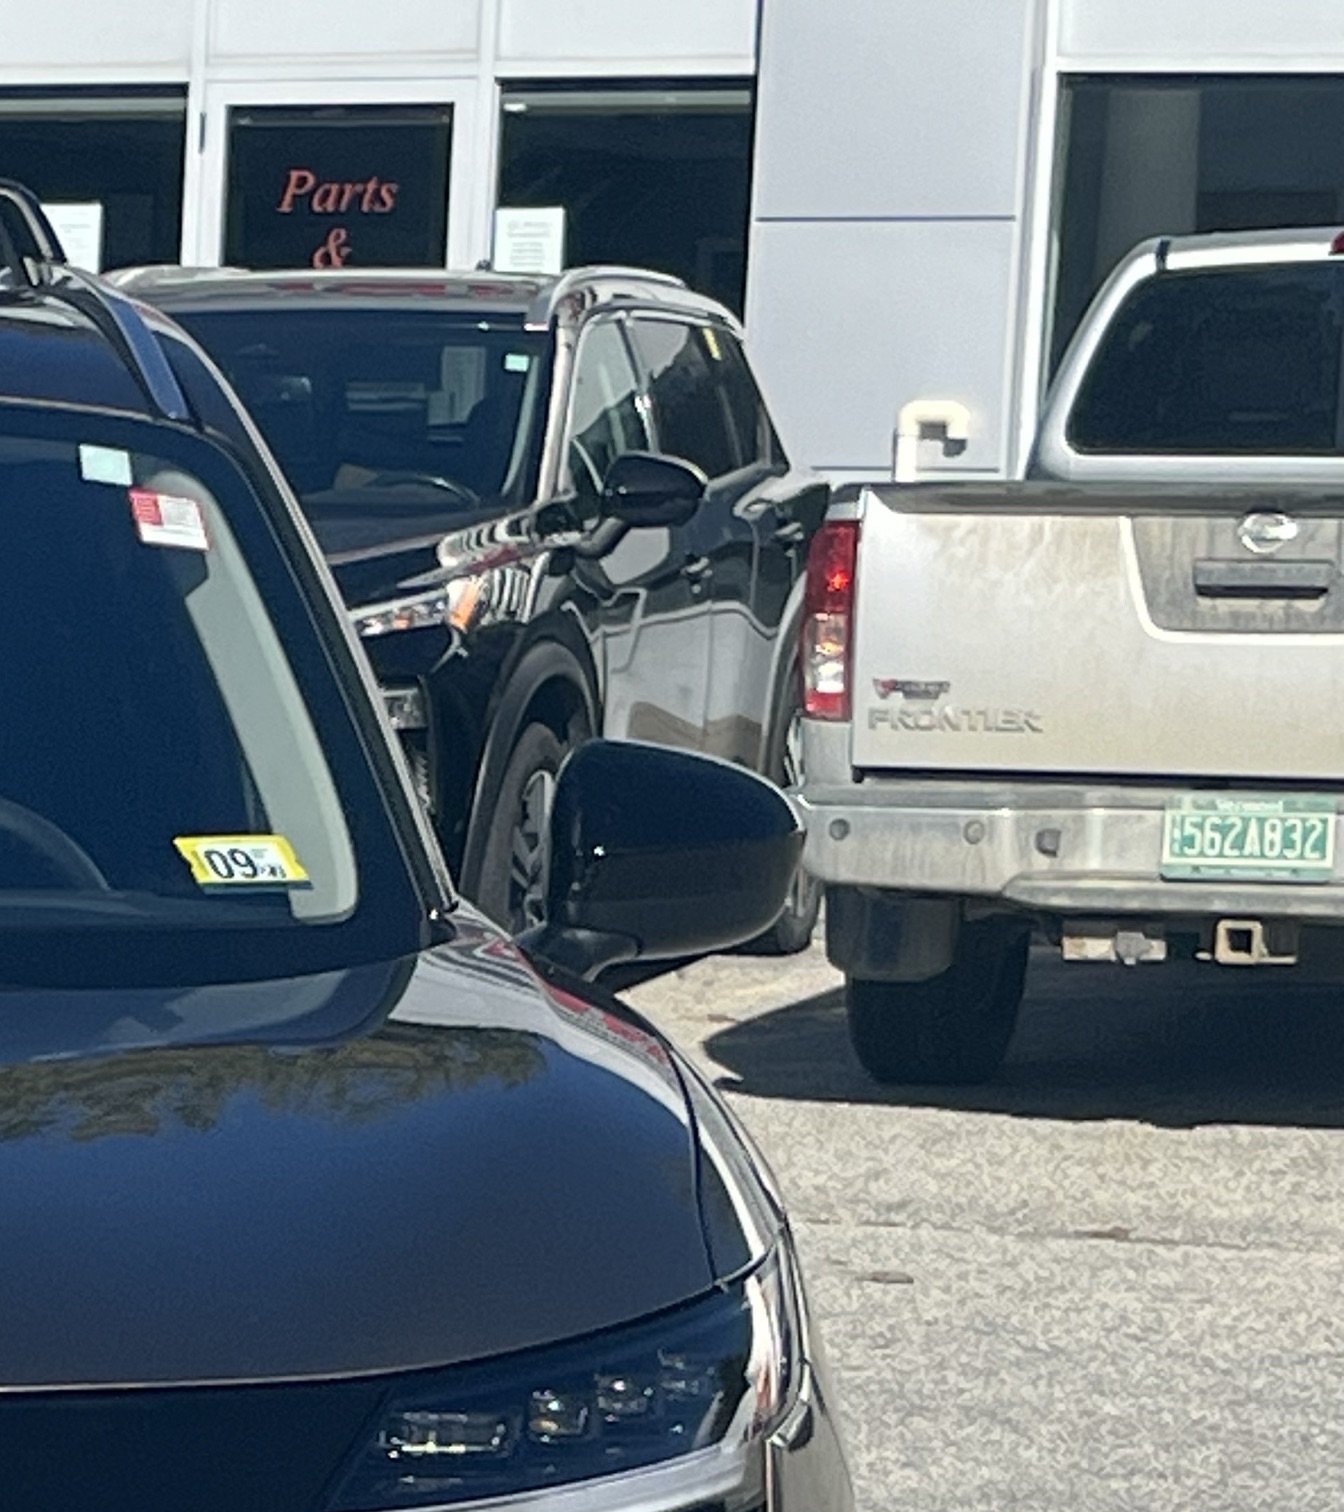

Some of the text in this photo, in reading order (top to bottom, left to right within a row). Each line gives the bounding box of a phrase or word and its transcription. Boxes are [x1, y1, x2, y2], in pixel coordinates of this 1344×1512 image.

[276, 169, 399, 213] Parts
[313, 228, 352, 269] &
[867, 707, 1044, 733] FRONTIER
[1182, 814, 1326, 860] 562A832
[204, 848, 258, 879] 09
